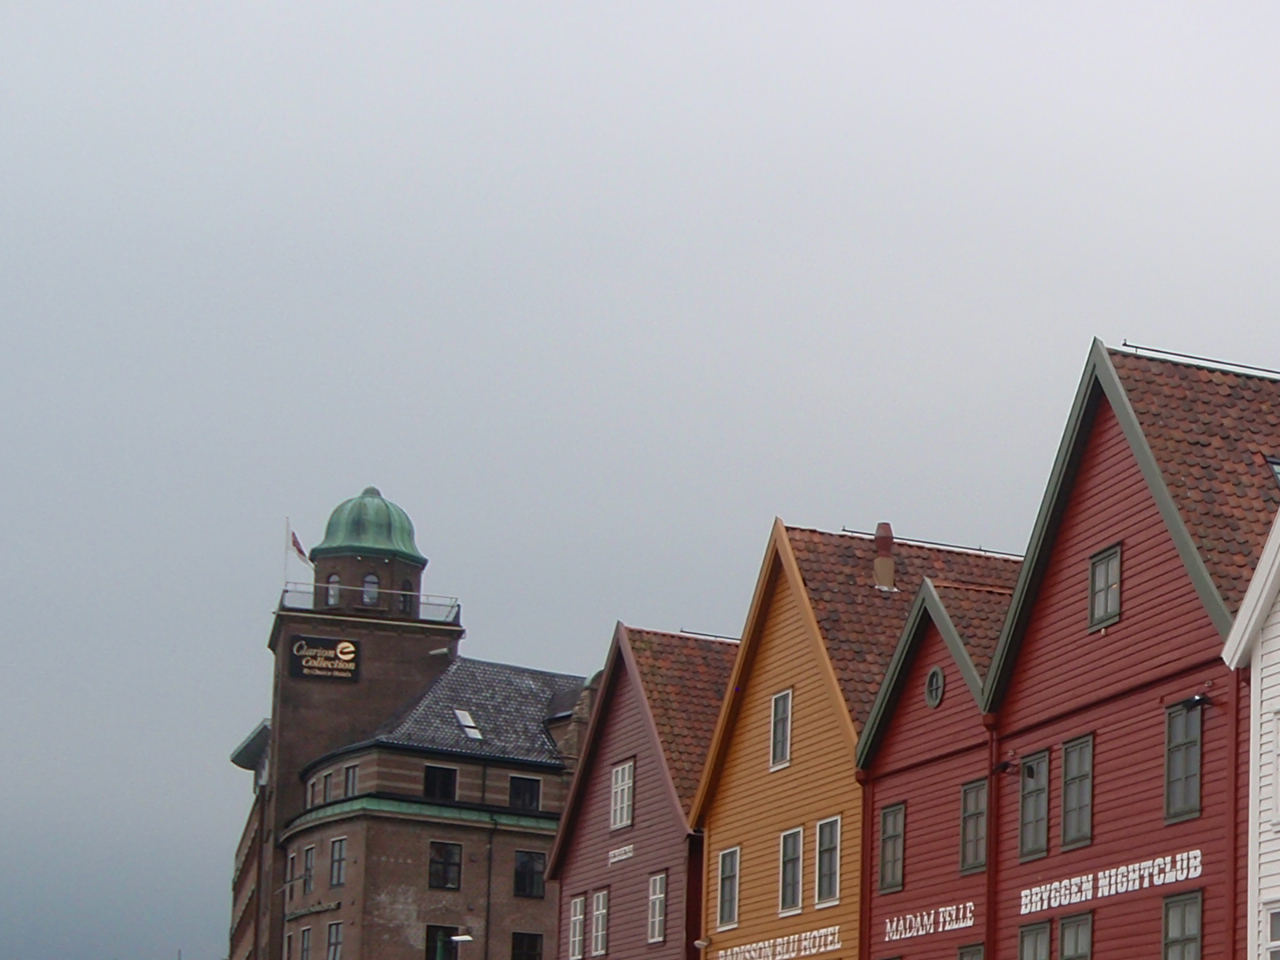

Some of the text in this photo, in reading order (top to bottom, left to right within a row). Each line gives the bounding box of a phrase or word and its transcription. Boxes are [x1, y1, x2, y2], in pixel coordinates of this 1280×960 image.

[293, 640, 335, 657] Clarion
[302, 656, 356, 670] Collection
[1020, 849, 1203, 915] BRYGGEN NIGHTCLUB
[884, 901, 975, 942] MADAM FELLE
[775, 934, 800, 960] BLU
[800, 925, 842, 956] HOTEL
